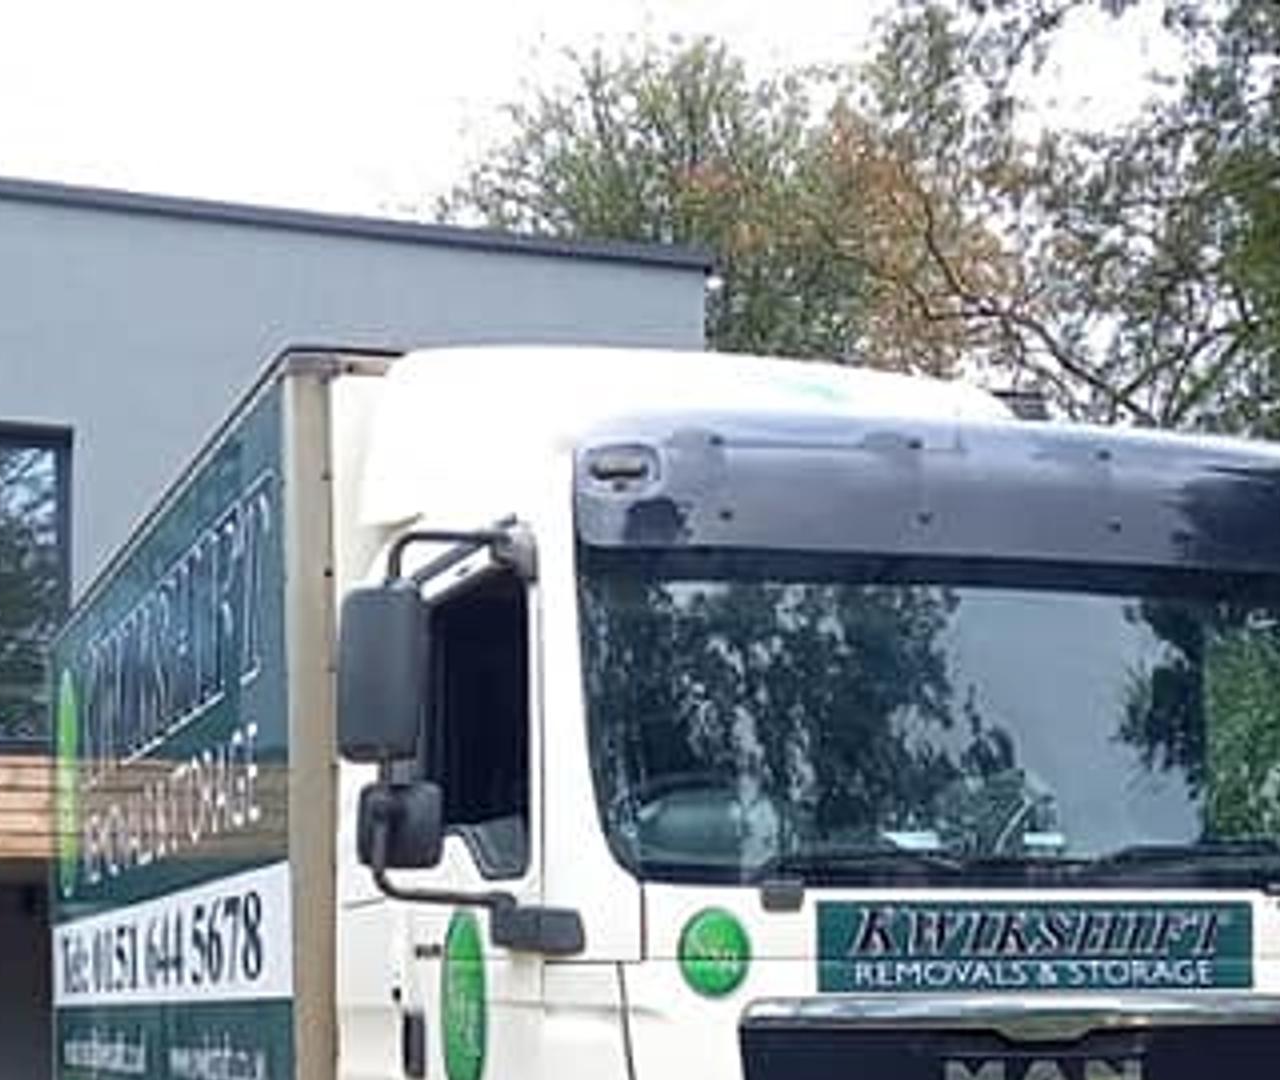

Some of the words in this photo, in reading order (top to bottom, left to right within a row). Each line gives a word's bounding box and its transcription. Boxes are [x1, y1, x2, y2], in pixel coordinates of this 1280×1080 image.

[93, 922, 137, 992] 0151
[144, 905, 184, 987] 644
[191, 890, 264, 985] 5678
[847, 905, 1230, 958] KWIKSHIFT
[855, 958, 1027, 986] REMOVALS
[1033, 959, 1058, 985] &
[1070, 958, 1214, 985] STORAGE
